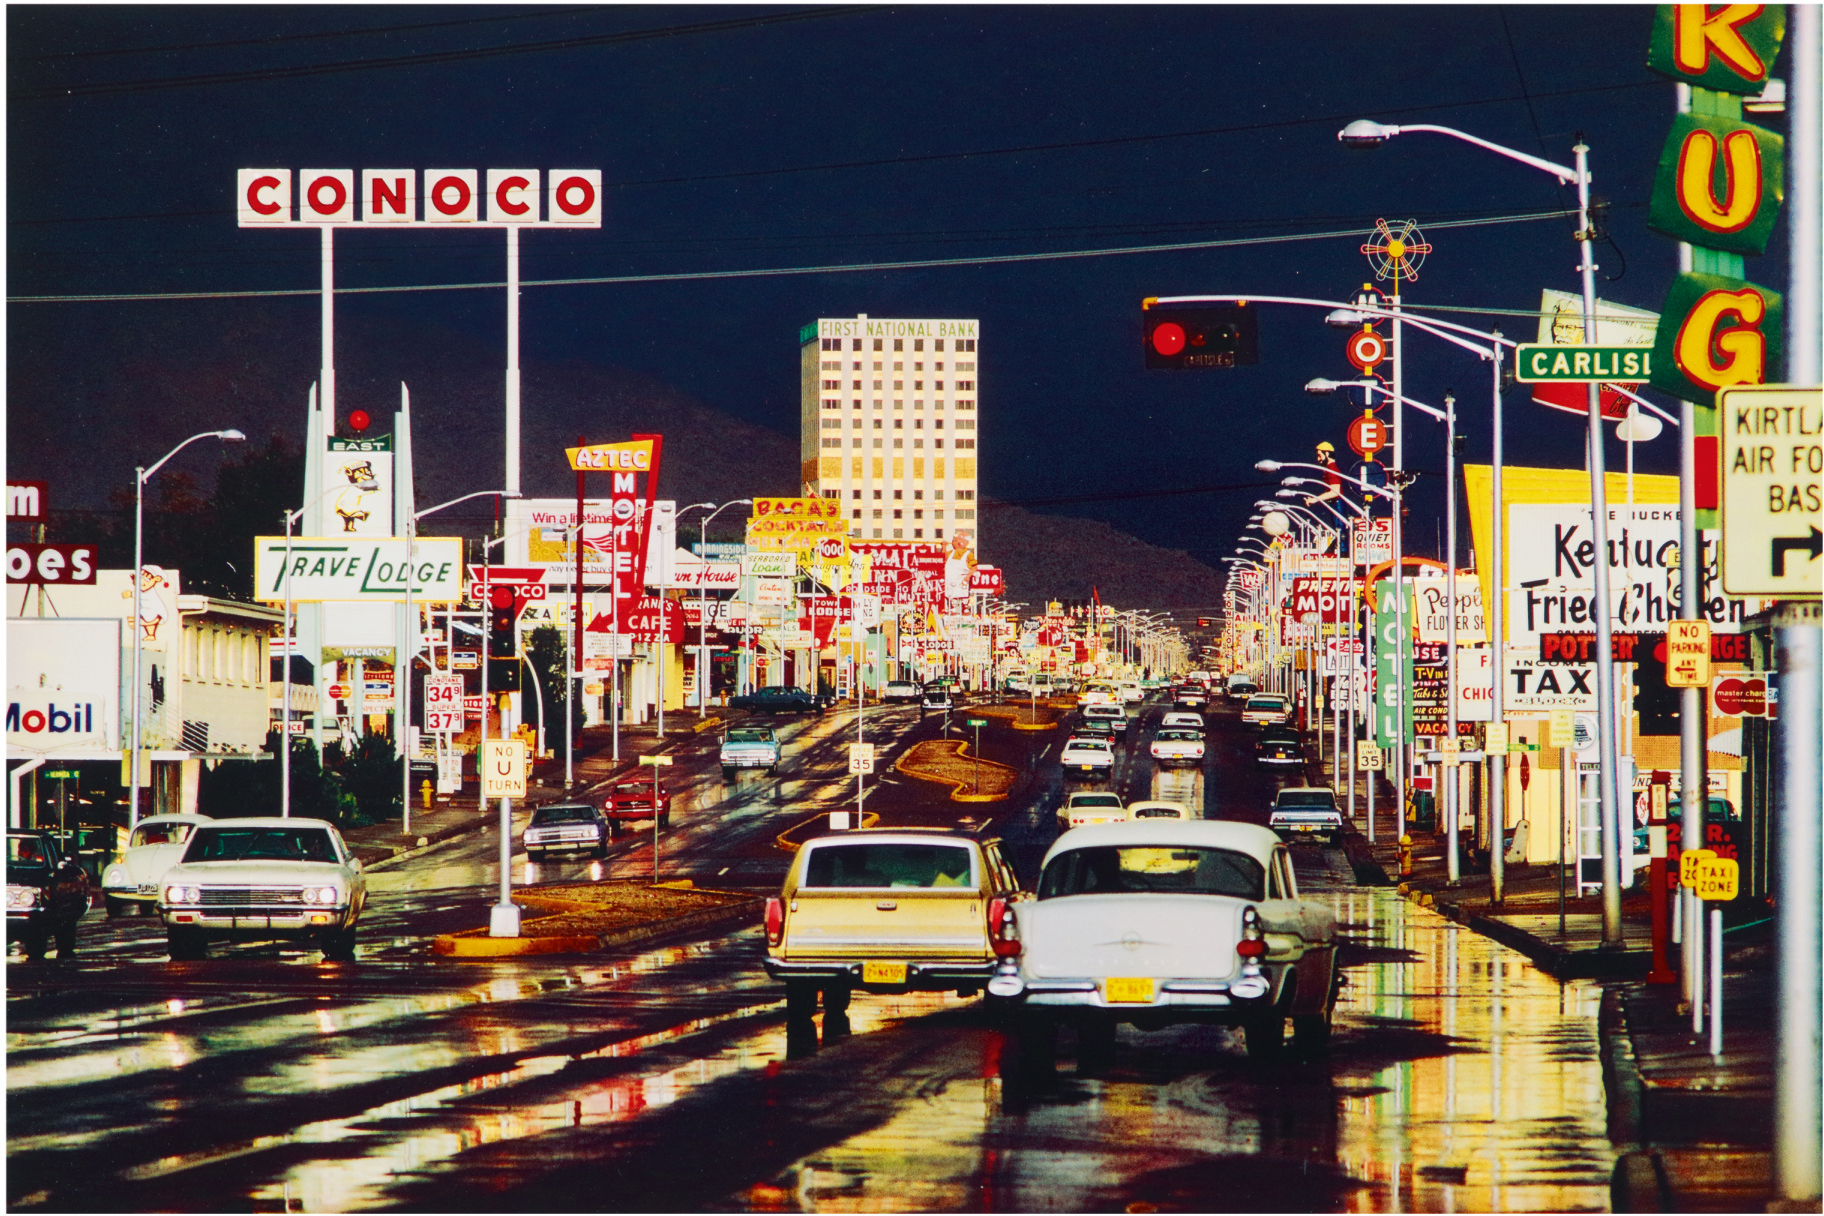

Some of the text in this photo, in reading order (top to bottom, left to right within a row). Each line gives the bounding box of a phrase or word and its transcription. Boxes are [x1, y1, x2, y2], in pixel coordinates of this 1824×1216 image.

[247, 176, 595, 215] CONOCO
[821, 321, 860, 337] FIRST
[866, 321, 933, 337] NATIONAL
[939, 322, 976, 338] BANK
[333, 442, 385, 451] EAST
[576, 448, 648, 468] AZTEC
[1733, 446, 1775, 474] AIR
[1769, 485, 1821, 513] BAS
[757, 500, 839, 518] BACA'S
[532, 512, 557, 524] Win
[559, 514, 567, 524] a
[751, 520, 844, 533] COCKTAILS
[614, 472, 635, 598] MOTEL
[696, 566, 738, 585] House
[808, 607, 851, 617] LODGE
[627, 615, 672, 631] CAFE
[629, 632, 671, 642] PIZZA
[1679, 626, 1699, 637] NO
[341, 648, 392, 657] VACANCY
[1671, 642, 1706, 655] PARKING
[1381, 591, 1409, 738] MOTEL
[1510, 669, 1592, 695] TAX
[1679, 673, 1698, 681] TIME
[1716, 689, 1743, 697] master
[7, 702, 92, 733] Mobil
[1415, 723, 1473, 734] VACACY
[495, 746, 513, 757] NO
[852, 758, 871, 770] 35
[1360, 755, 1379, 767] 35
[497, 761, 511, 775] U
[488, 780, 522, 791] TURN
[1702, 866, 1733, 877] TAXI
[1700, 881, 1733, 893] ZONE
